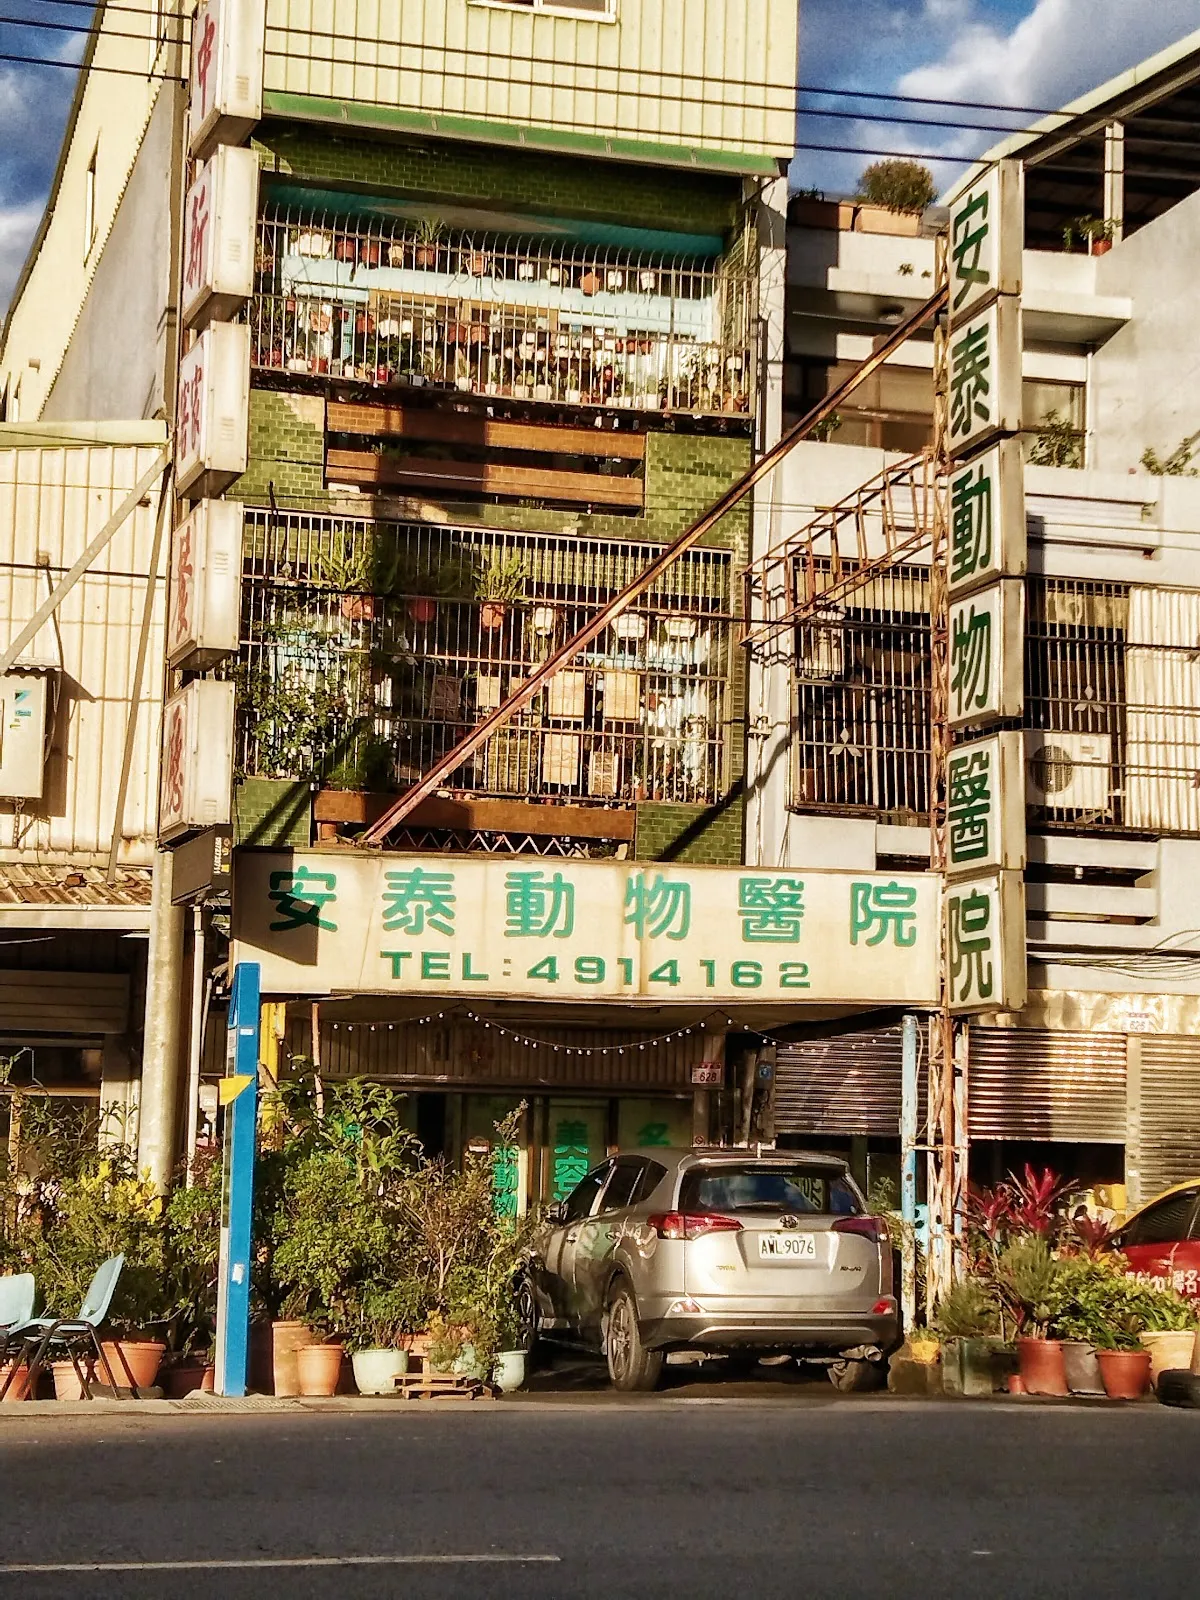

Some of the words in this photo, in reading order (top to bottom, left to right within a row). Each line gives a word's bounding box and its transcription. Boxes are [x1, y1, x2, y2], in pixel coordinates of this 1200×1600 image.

[948, 191, 992, 1005] 安泰動物醫院
[268, 866, 917, 947] 安泰動物醫院
[699, 1071, 717, 1082] 628
[553, 1119, 589, 1201] 美容
